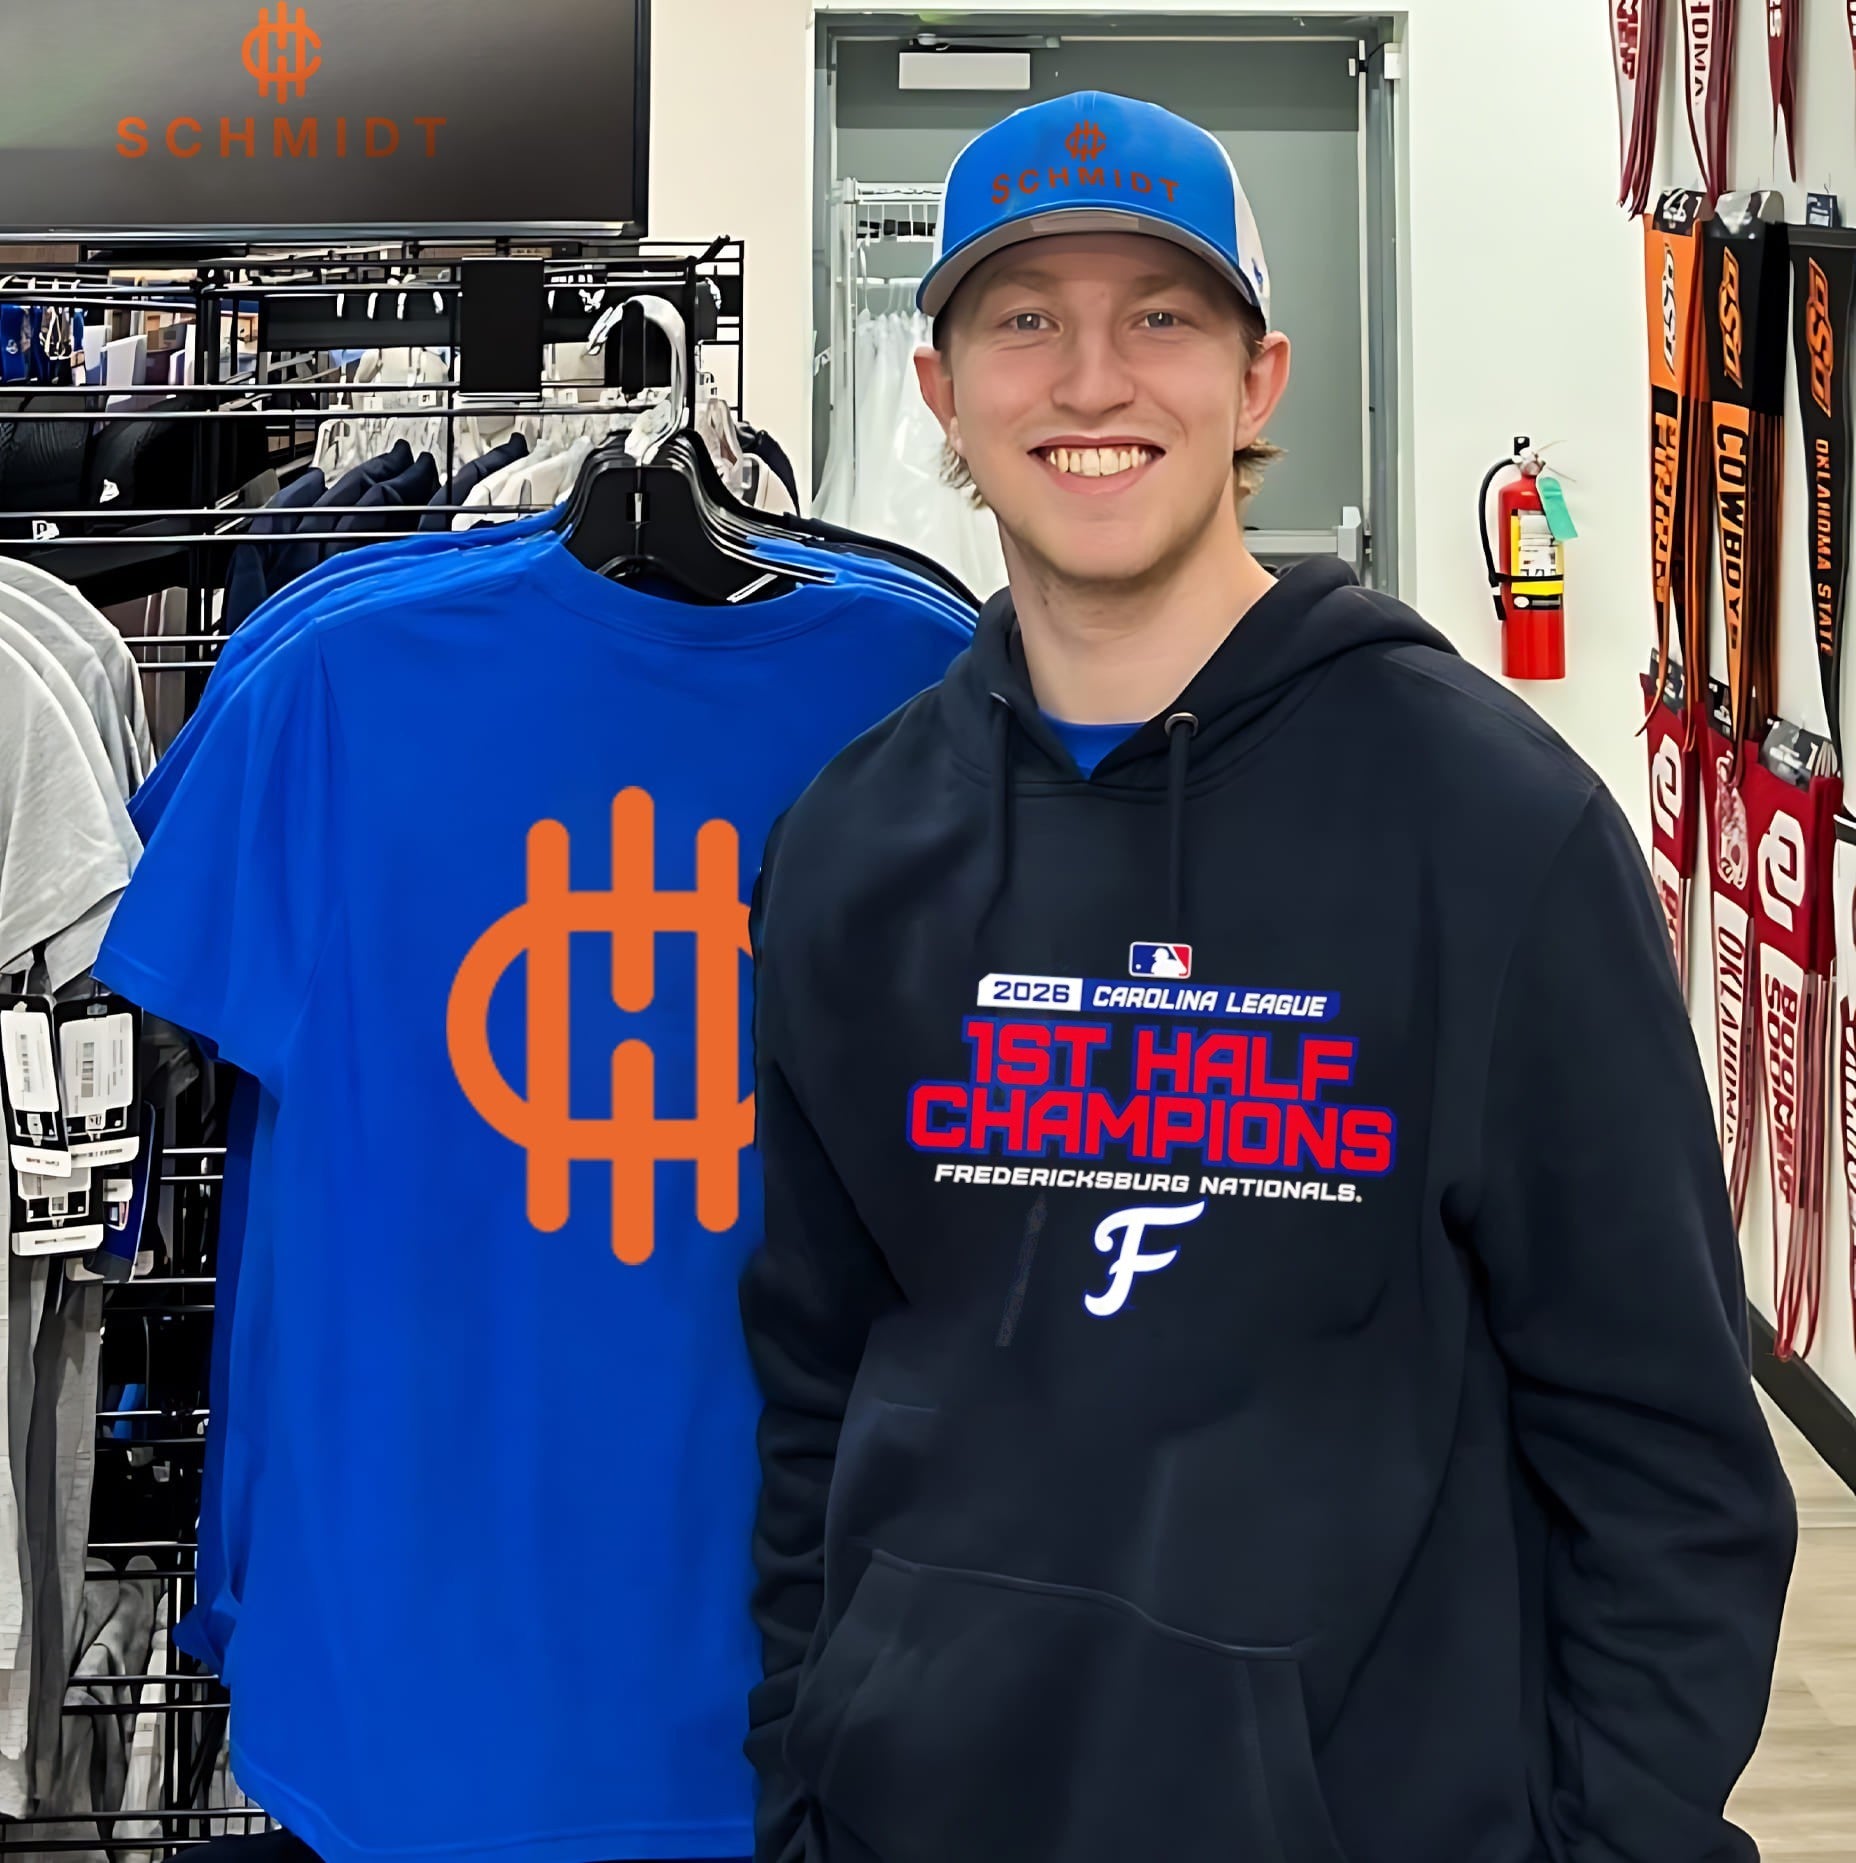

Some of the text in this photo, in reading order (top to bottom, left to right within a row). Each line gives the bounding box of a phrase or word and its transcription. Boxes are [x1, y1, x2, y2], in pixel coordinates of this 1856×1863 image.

[116, 116, 447, 159] SCHMIDT
[991, 166, 1181, 205] SCHMIDT
[1814, 438, 1832, 571] OKLAHOMA
[993, 982, 1328, 1017] 2026 CAROLINA LEAGUE
[965, 1021, 1355, 1101] 1ST HALF
[910, 1084, 1395, 1174] CHAMPIONS
[933, 1163, 1191, 1194] FREDERICKSBURG
